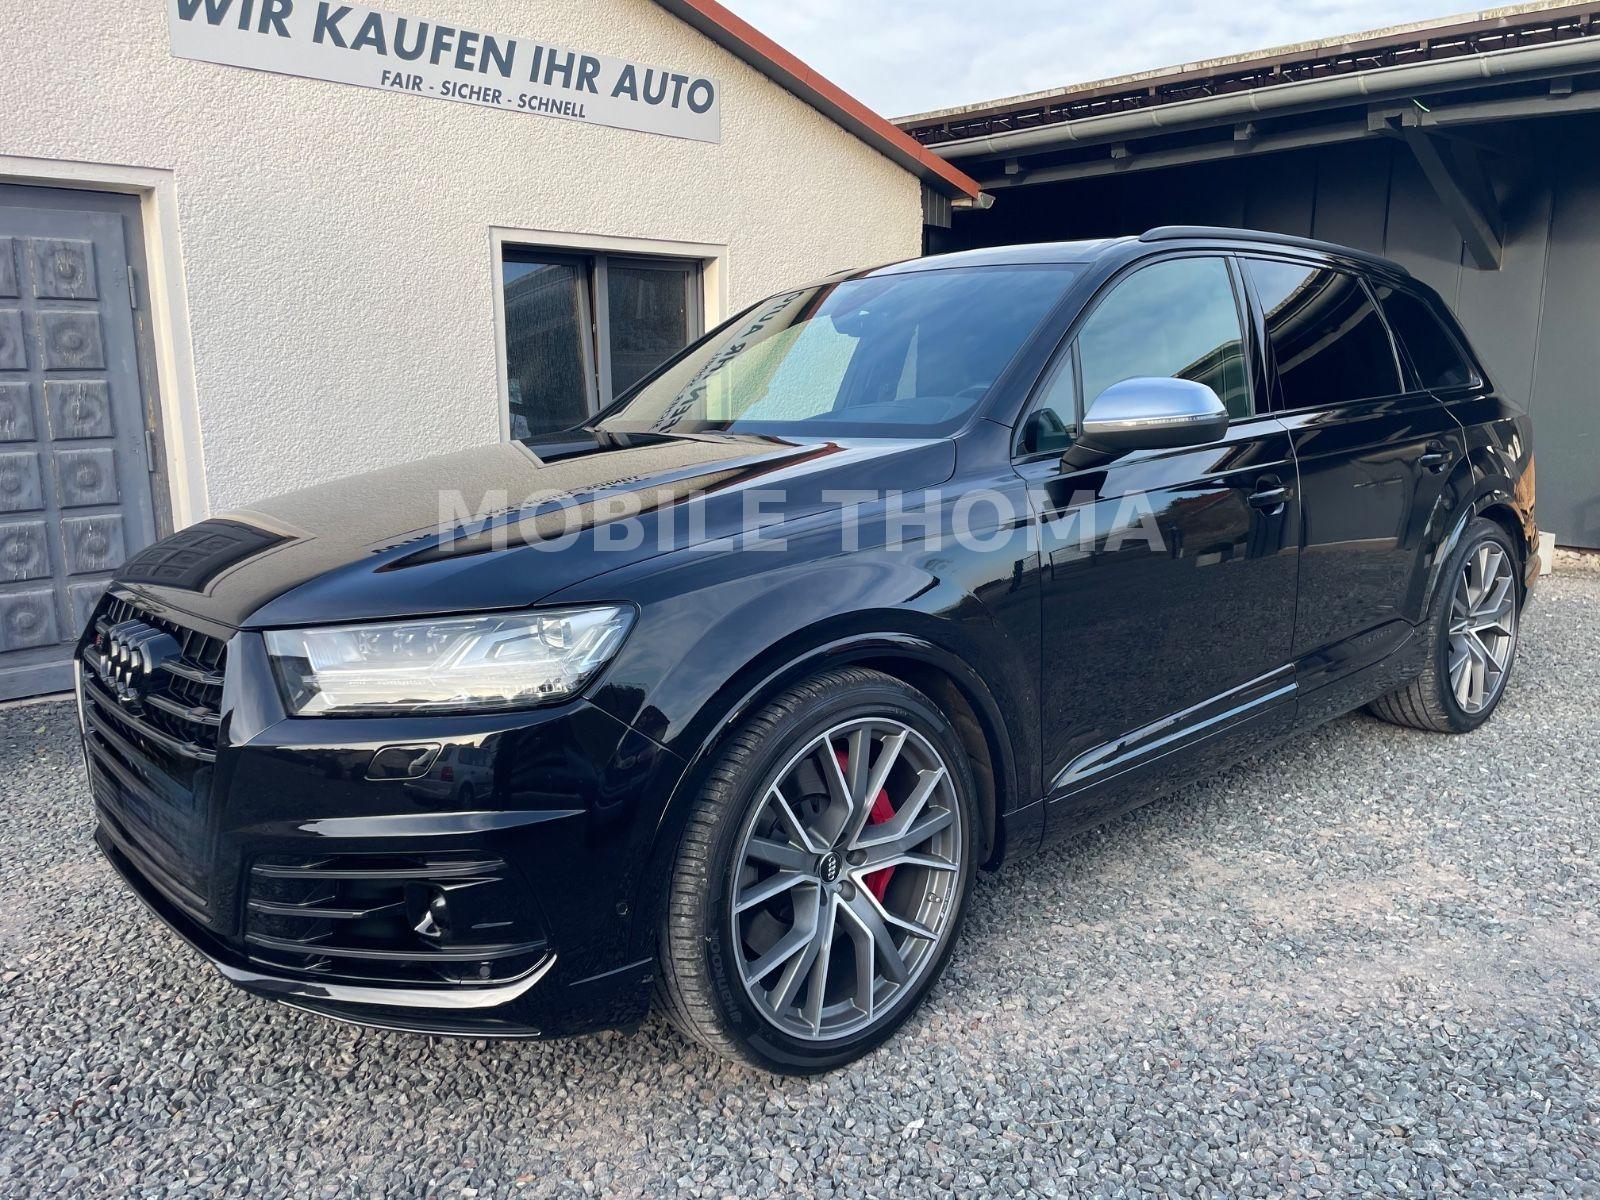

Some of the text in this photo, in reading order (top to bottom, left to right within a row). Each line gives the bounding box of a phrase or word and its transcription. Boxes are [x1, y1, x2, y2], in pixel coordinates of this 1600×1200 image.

[177, 0, 715, 114] WIR KAUFEN IHR AUTO
[380, 69, 424, 92] FAIR
[440, 80, 503, 104] SICHER
[517, 93, 586, 118] SCHNELL
